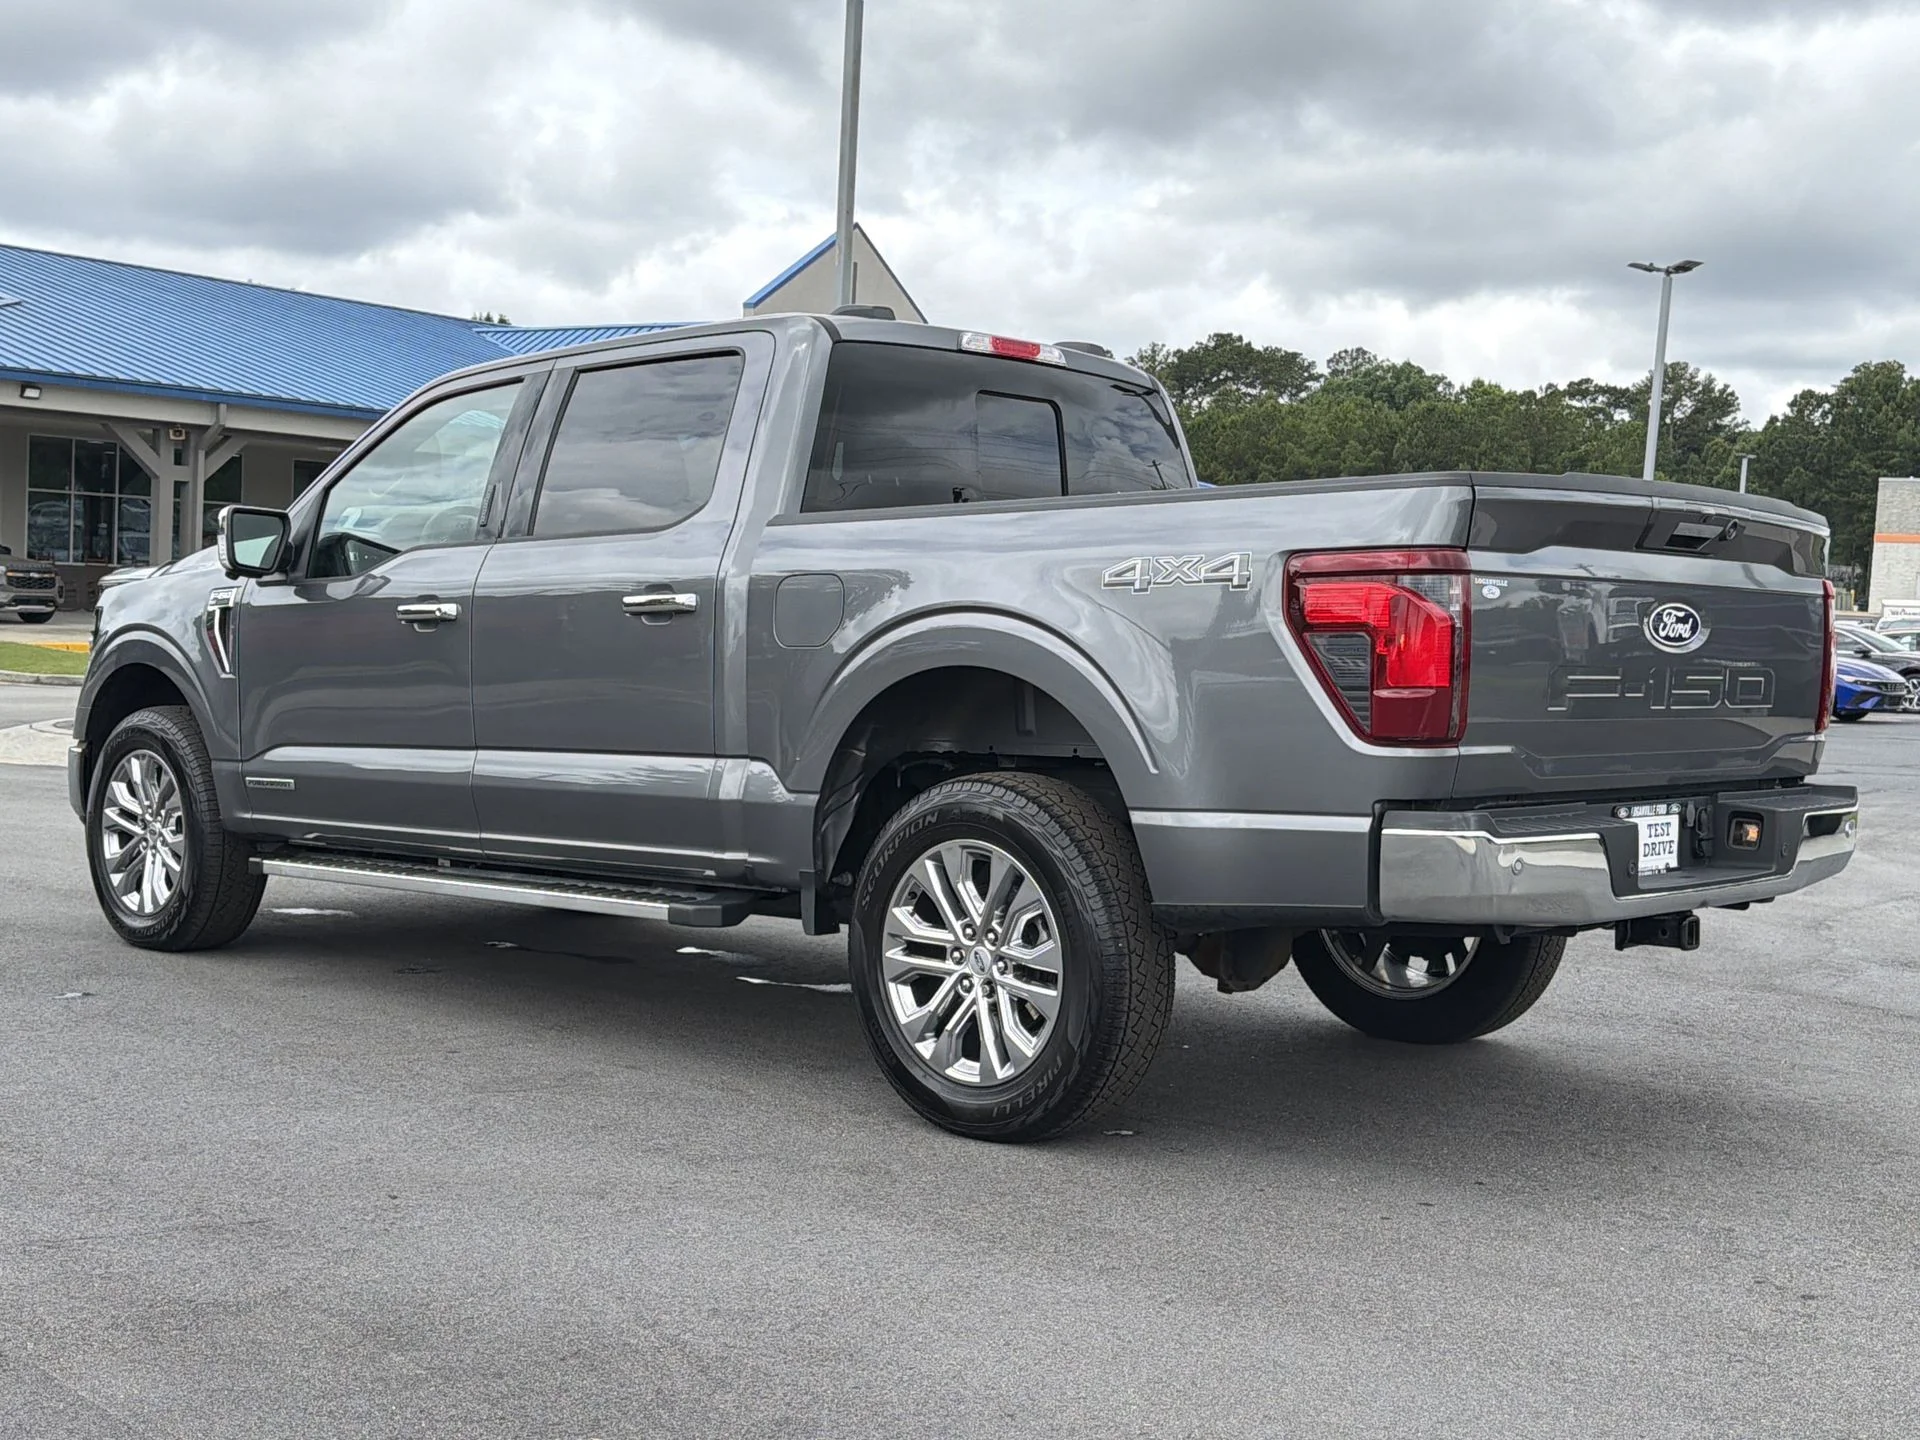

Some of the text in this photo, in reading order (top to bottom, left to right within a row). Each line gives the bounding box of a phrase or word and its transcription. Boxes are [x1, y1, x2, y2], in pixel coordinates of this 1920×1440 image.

[1658, 608, 1694, 639] Ford
[1547, 667, 1775, 711] F-150
[1643, 840, 1674, 857] DRIVE
[1647, 822, 1671, 838] TEST
[861, 811, 939, 911] SCORPION
[992, 1055, 1062, 1117] PIRELLI
